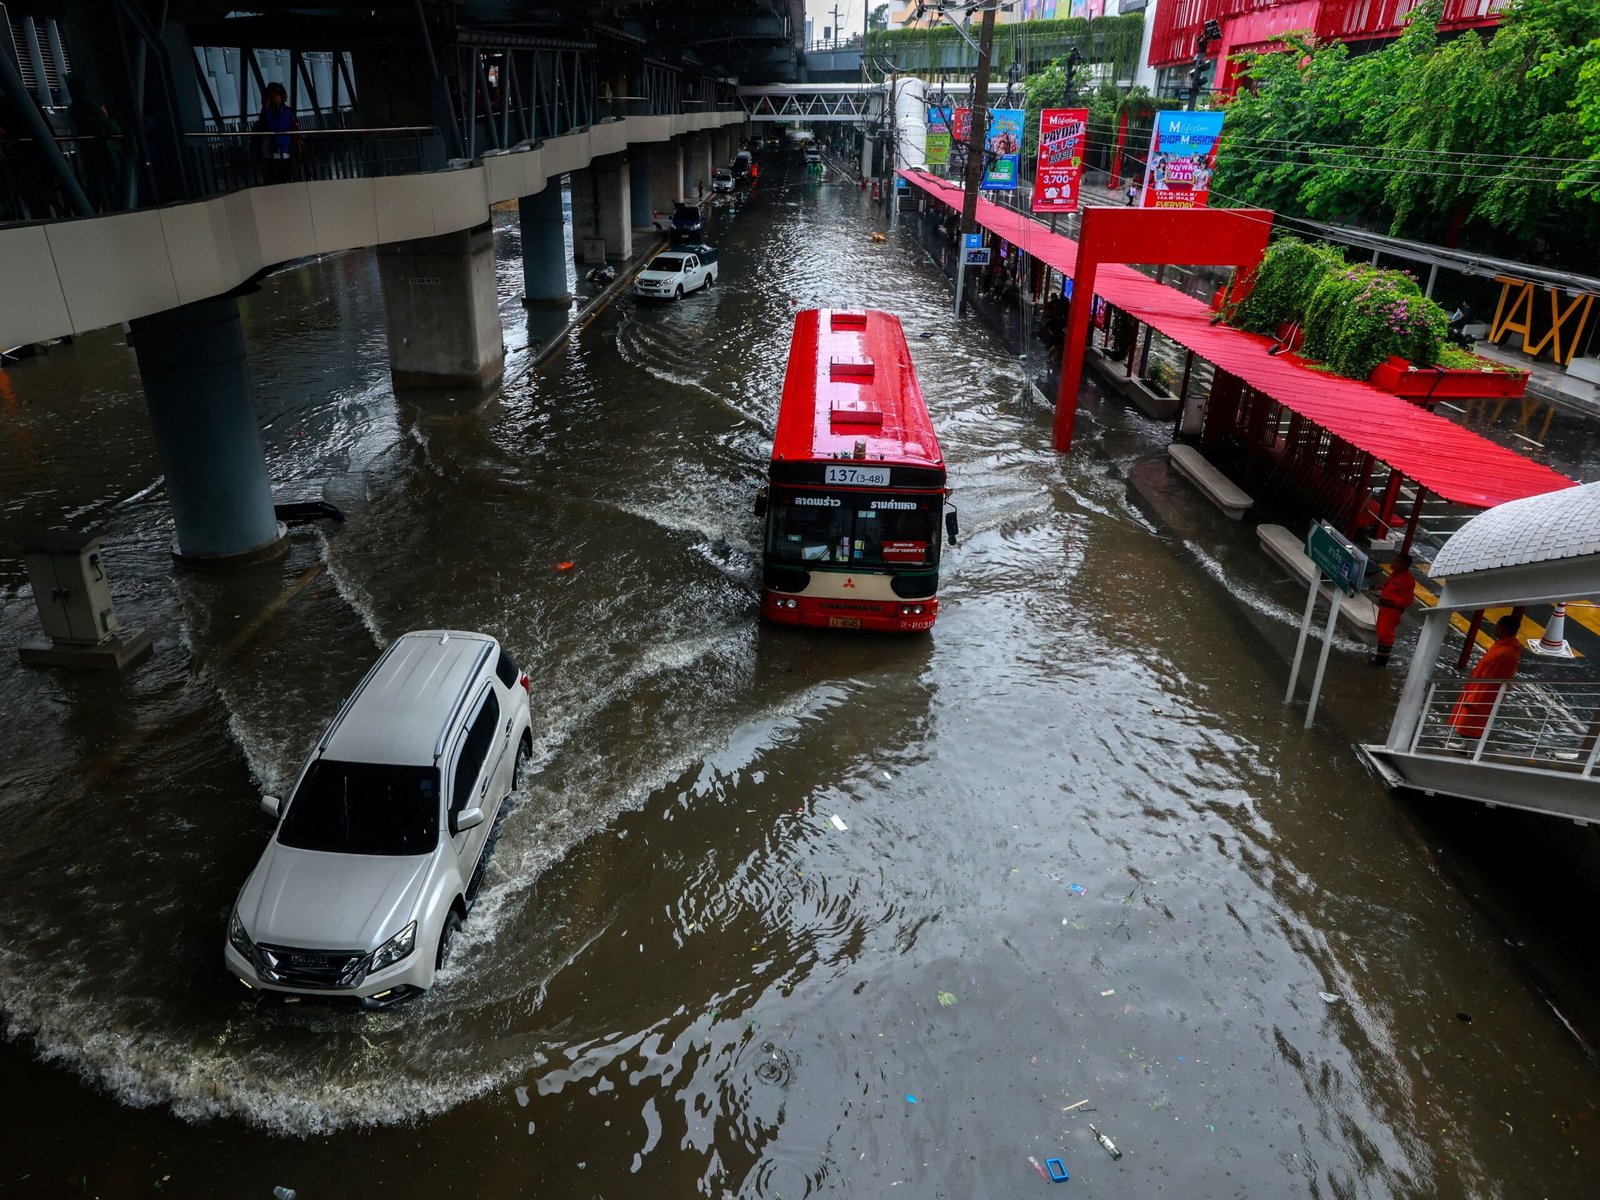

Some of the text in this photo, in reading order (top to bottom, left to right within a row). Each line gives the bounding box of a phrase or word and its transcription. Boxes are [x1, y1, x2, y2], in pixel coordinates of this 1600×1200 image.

[1044, 121, 1082, 145] PAYDAY
[1043, 174, 1069, 184] 3,700
[1488, 274, 1595, 366] TAXI
[795, 496, 841, 507] ลาดพร้าว
[870, 499, 917, 510] รามคำแหง
